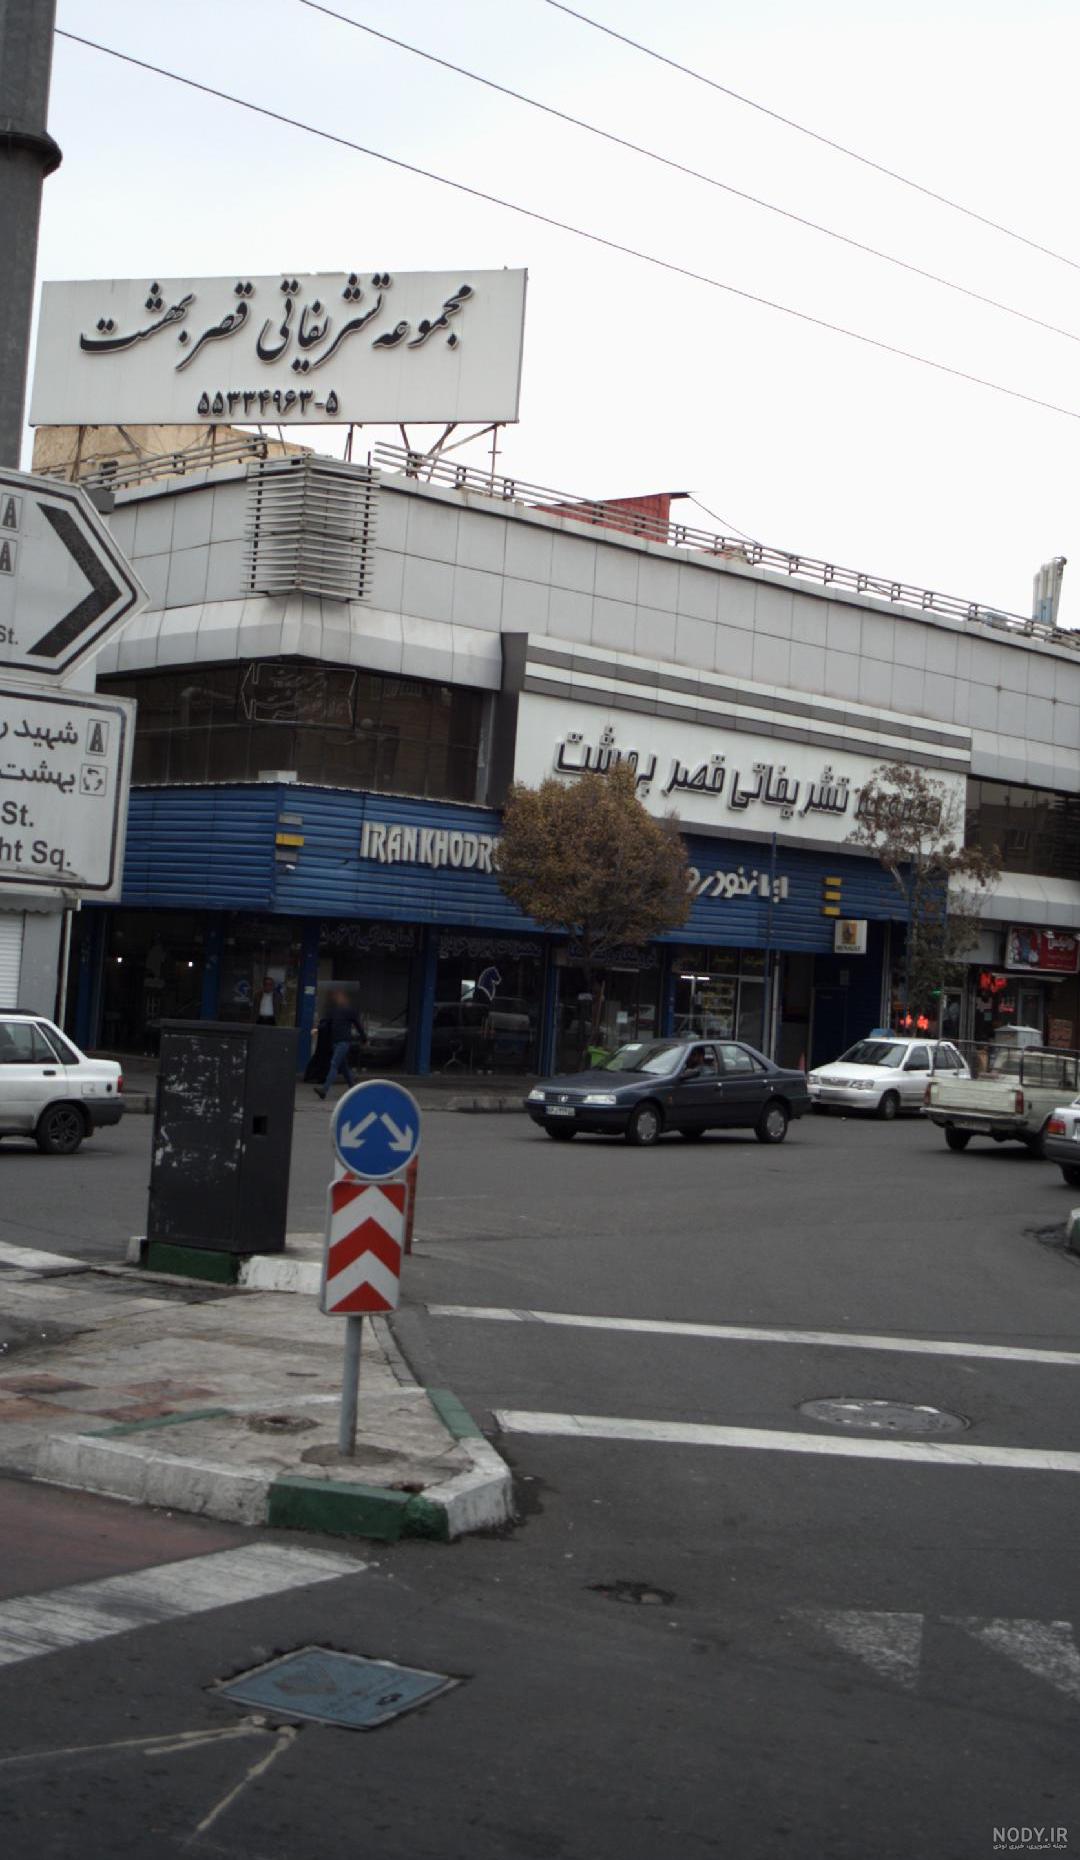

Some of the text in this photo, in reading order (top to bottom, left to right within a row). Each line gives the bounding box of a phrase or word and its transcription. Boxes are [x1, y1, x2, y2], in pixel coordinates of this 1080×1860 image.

[79, 272, 473, 374] مجموعه تشریفاتی قصر بهشت
[661, 754, 726, 797] قصر
[728, 753, 850, 819] تشریفاتی
[1, 800, 35, 827] St.
[31, 840, 72, 872] Sq.
